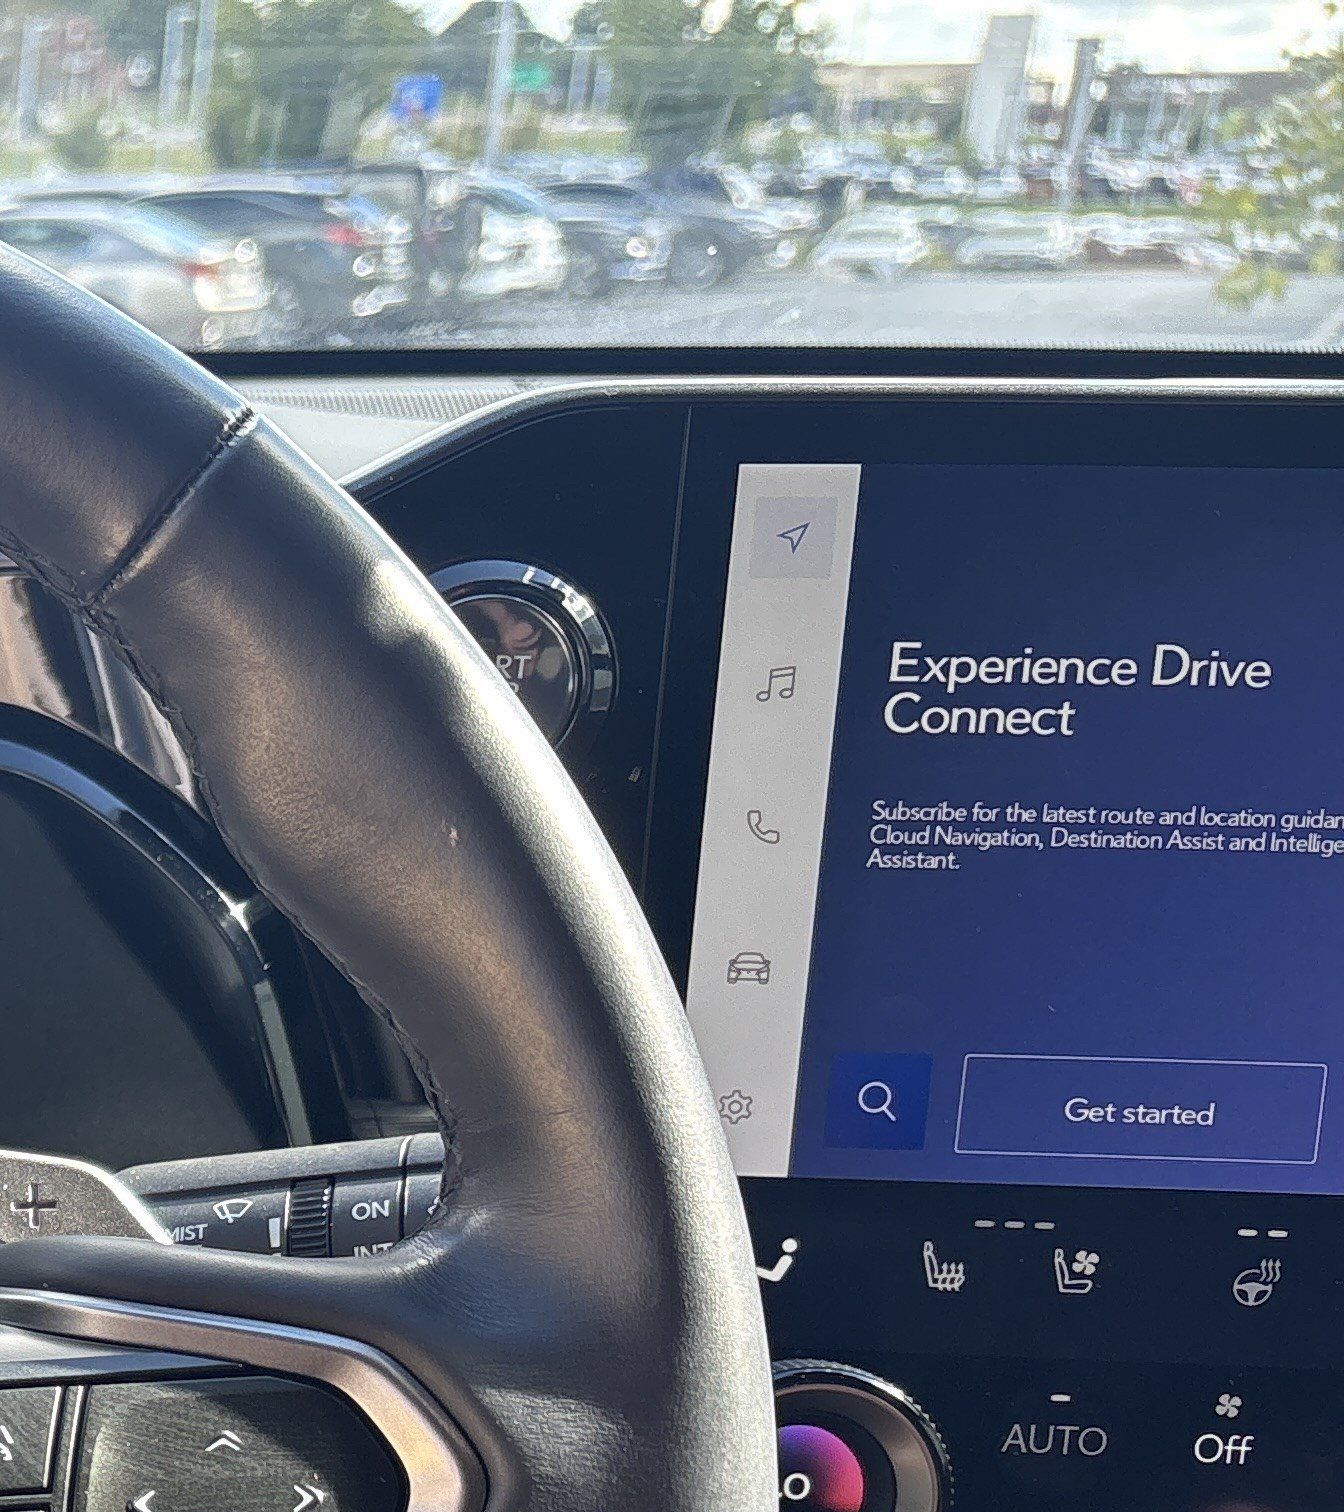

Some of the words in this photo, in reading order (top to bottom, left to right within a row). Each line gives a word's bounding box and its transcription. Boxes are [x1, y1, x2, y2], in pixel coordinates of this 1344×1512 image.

[888, 641, 1138, 693] Experience
[1151, 644, 1273, 688] Drive
[883, 692, 1077, 736] Connect
[871, 799, 968, 822] Subscribe
[972, 802, 1000, 823] for
[1006, 803, 1038, 824] the
[1042, 803, 1097, 824] latest
[1100, 807, 1155, 826] route
[1158, 806, 1197, 826] and
[1200, 806, 1276, 829] location
[869, 824, 931, 846] Cloud
[933, 826, 1045, 851] Navigation,
[1050, 826, 1162, 850] Destination
[1165, 829, 1226, 851] Assist
[1228, 832, 1267, 852] and
[865, 847, 961, 870] Assistant.
[1064, 1097, 1115, 1126] Get
[1121, 1102, 1216, 1127] started
[351, 1200, 391, 1221] ON
[164, 1223, 208, 1244] MIST
[1002, 1424, 1108, 1457] AUTO
[1194, 1433, 1255, 1465] Off
[778, 1472, 811, 1500] O
